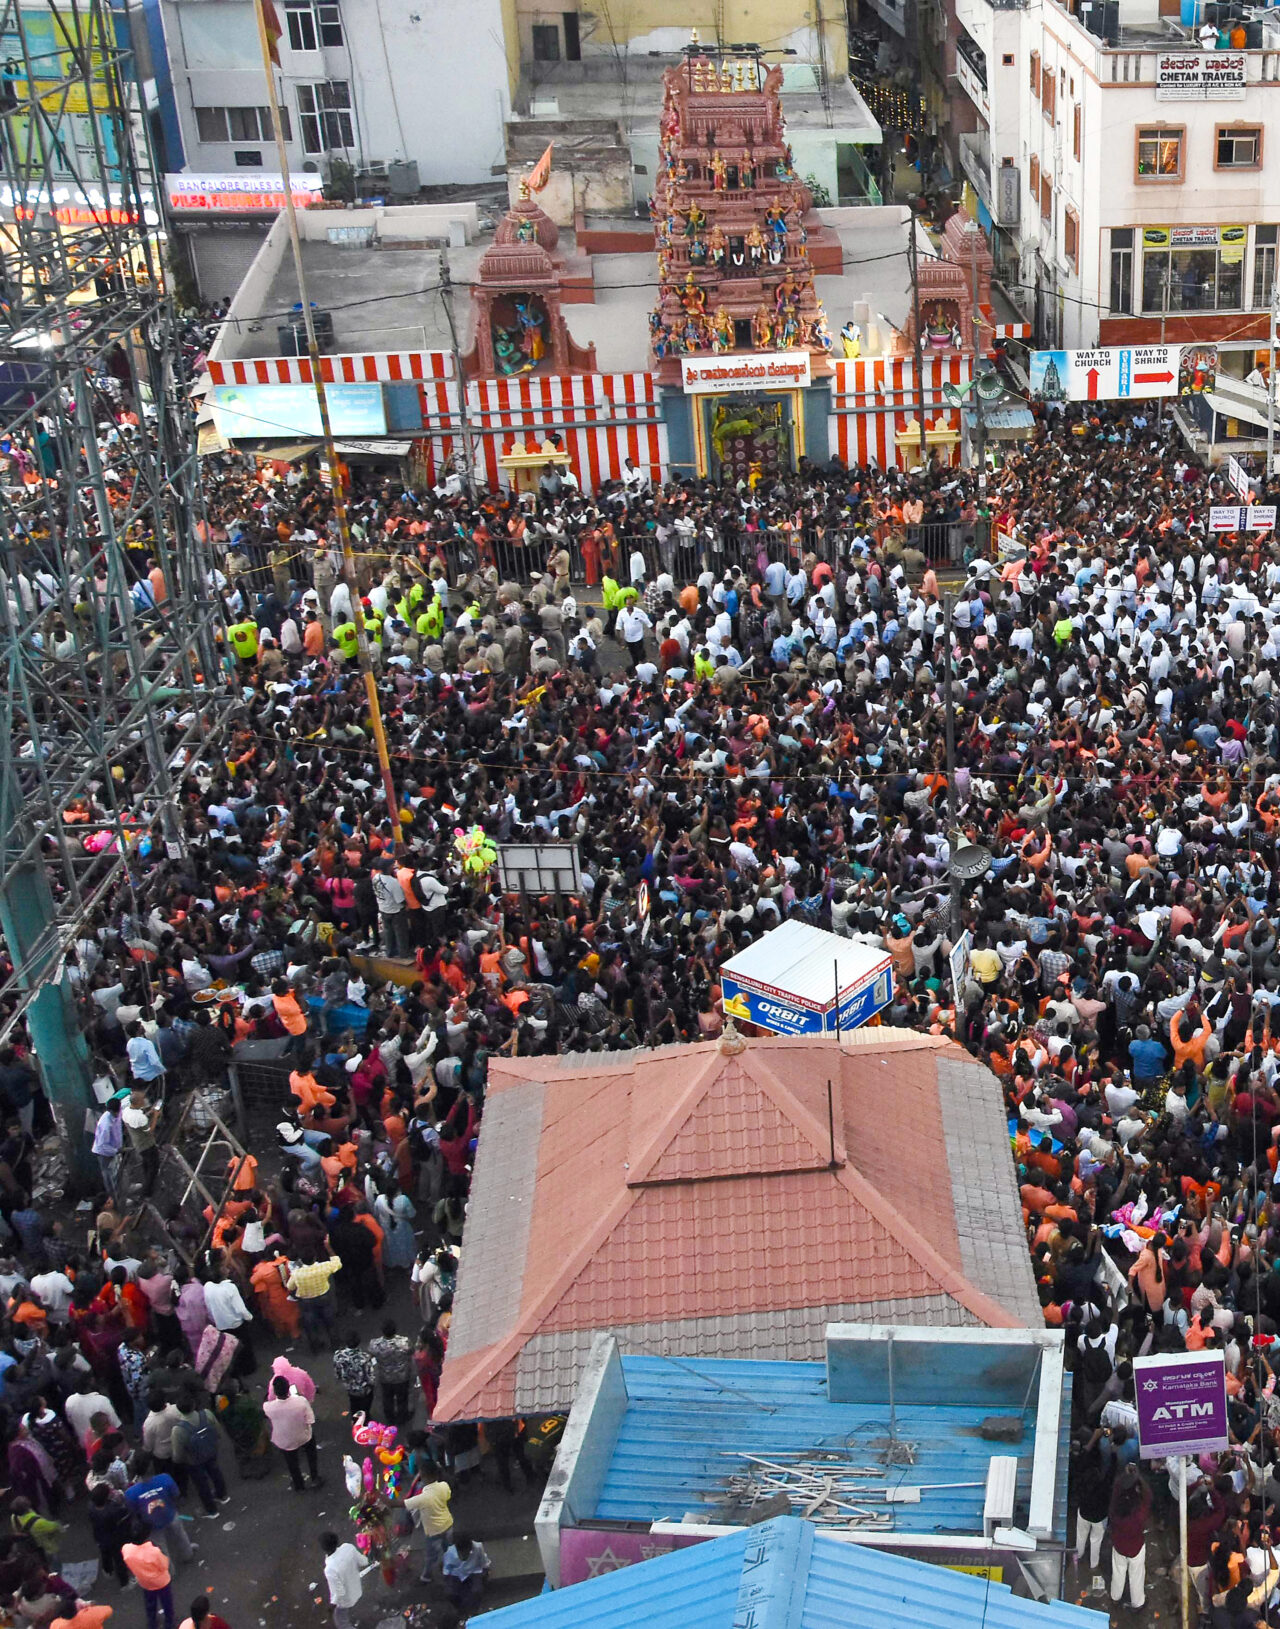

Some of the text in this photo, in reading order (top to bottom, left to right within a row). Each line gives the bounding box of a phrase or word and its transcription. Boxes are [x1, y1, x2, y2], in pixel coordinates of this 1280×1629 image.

[1160, 72, 1243, 81] CHETAN TRAVELS
[178, 181, 309, 191] BANGALORE PILES CNIC
[170, 193, 211, 209] PILES,
[1074, 359, 1111, 367] CHURCH
[1135, 356, 1168, 365] SHRINE
[730, 972, 763, 988] BENGALURU
[764, 983, 776, 994] CITY
[777, 989, 801, 1003] TRAFFIC
[801, 999, 821, 1010] POLICE
[758, 1001, 811, 1025] ORBIT
[1162, 1382, 1199, 1390] Karnataka
[1152, 1402, 1214, 1421] ATM
